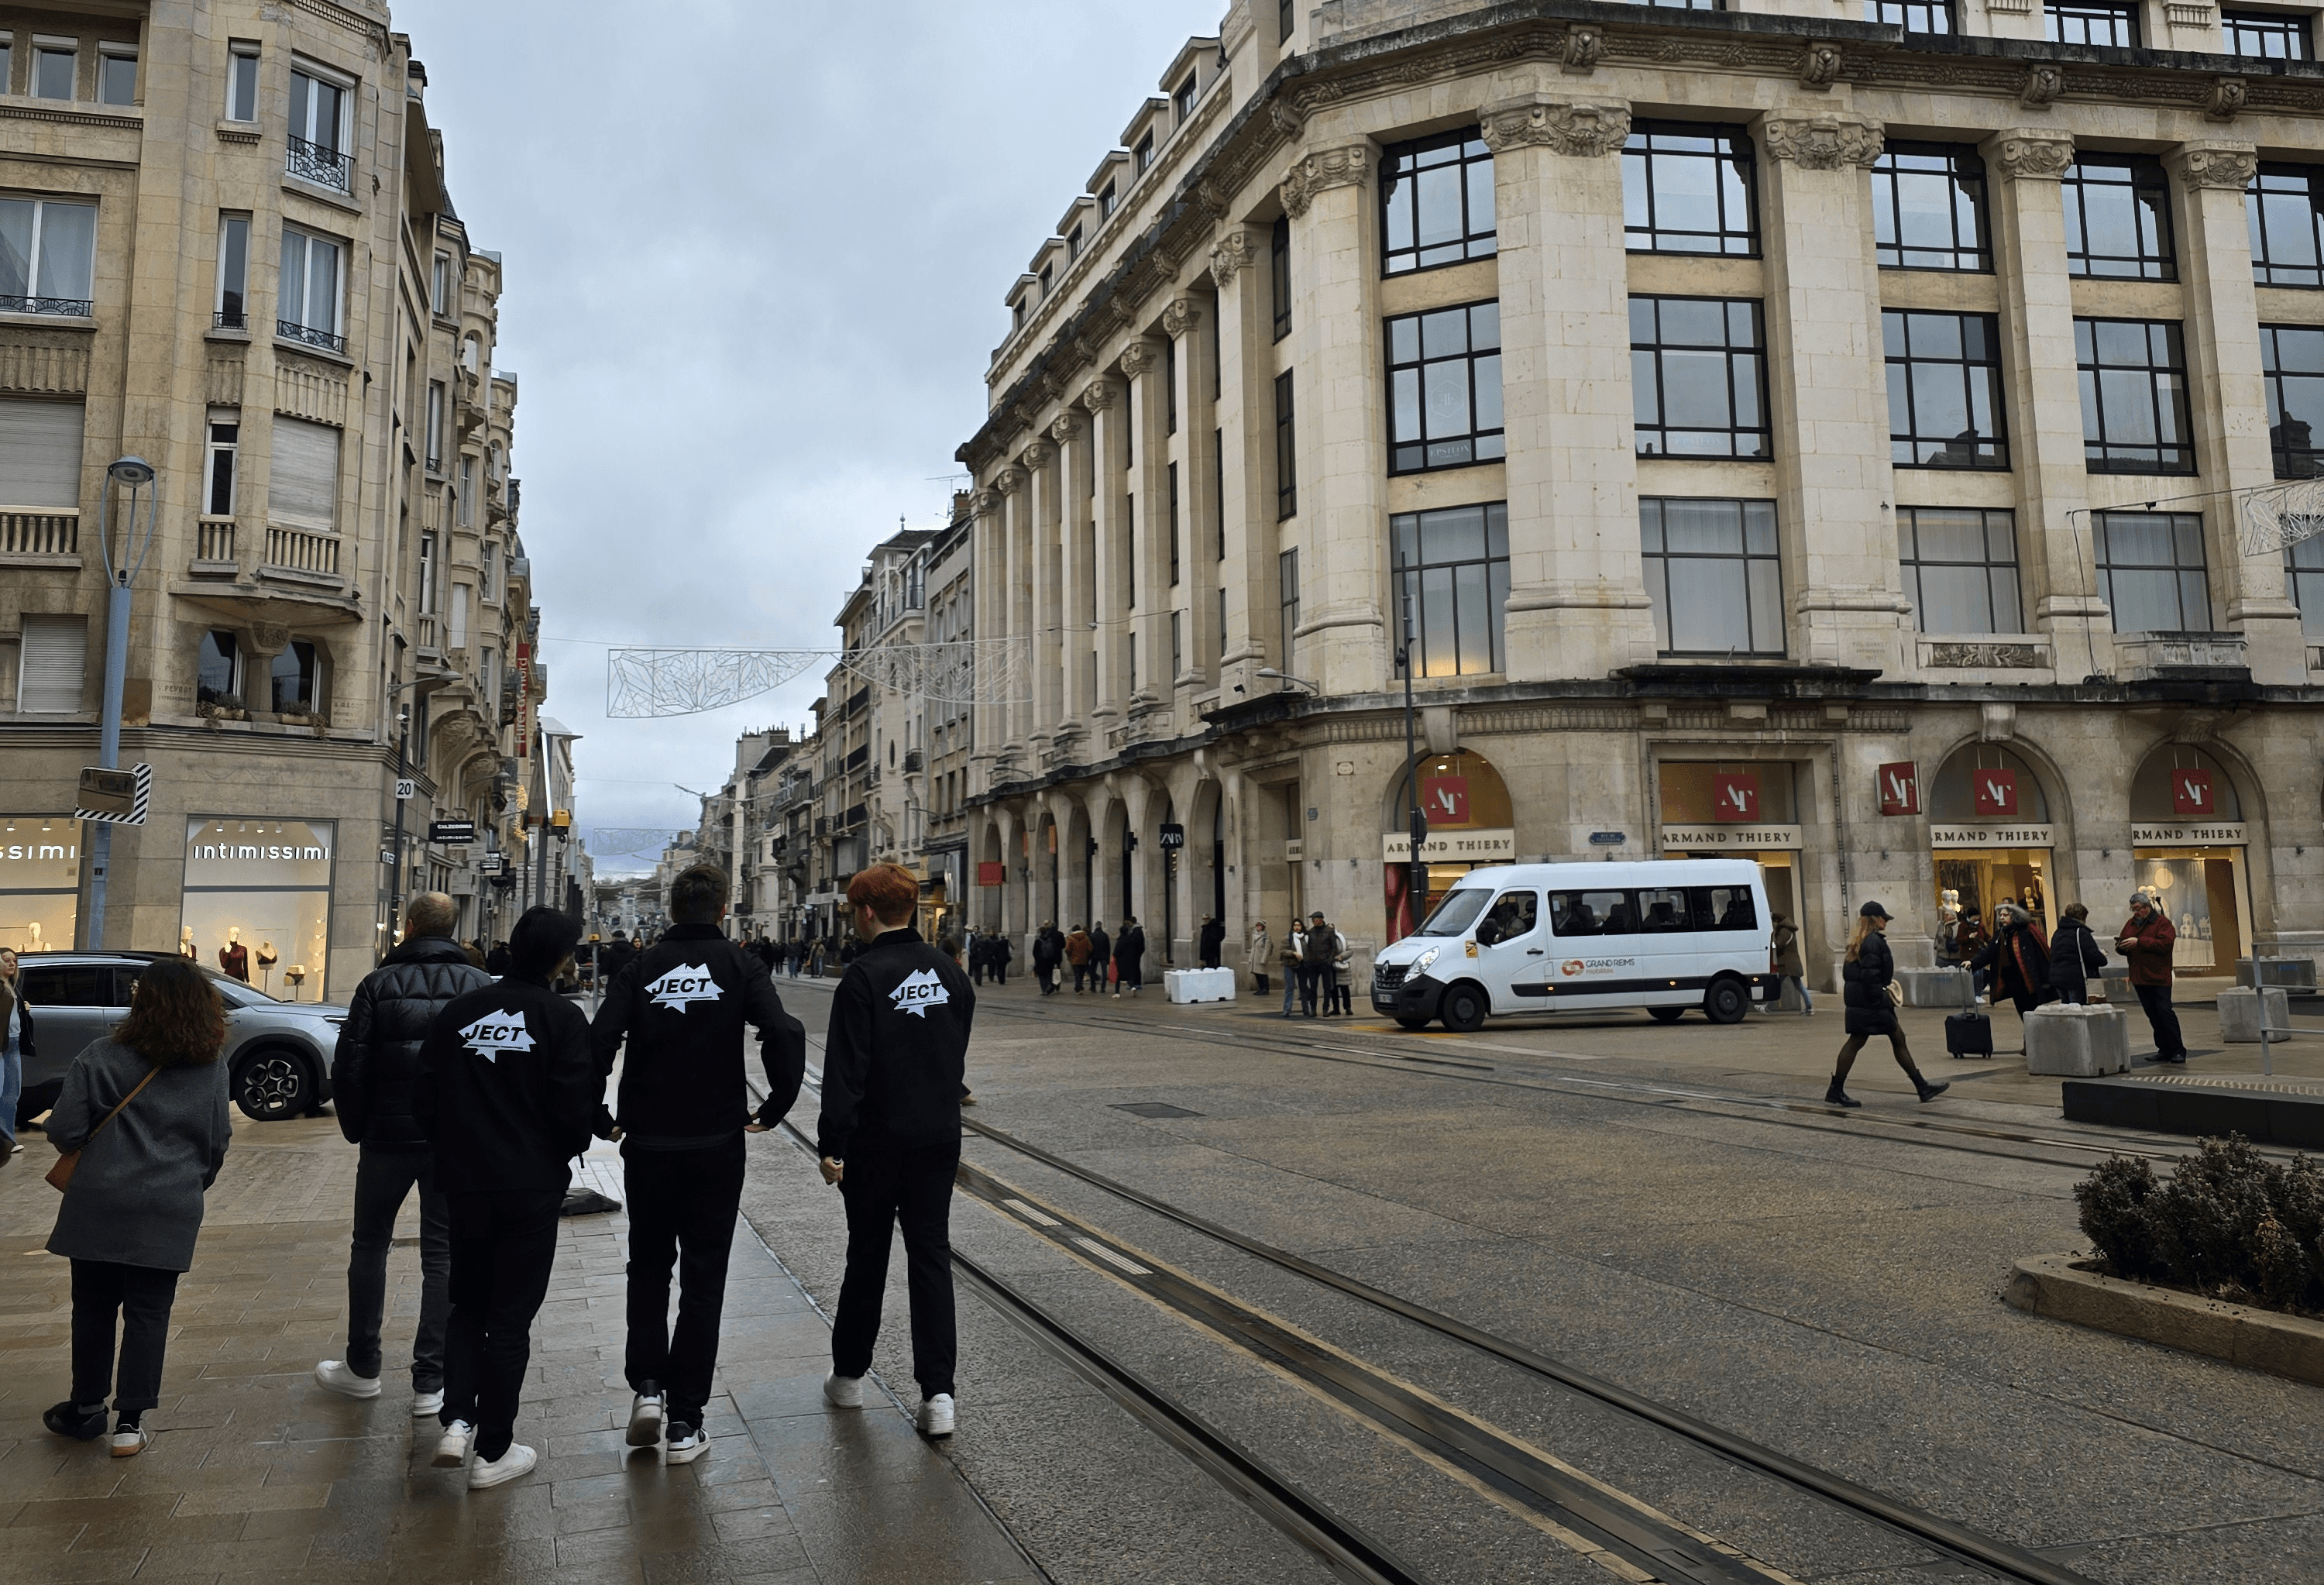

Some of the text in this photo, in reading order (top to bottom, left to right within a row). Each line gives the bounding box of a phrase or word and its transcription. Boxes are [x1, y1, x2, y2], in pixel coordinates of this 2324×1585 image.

[397, 782, 411, 795] 20
[1662, 832, 1791, 843] ARMAND THIERY
[1931, 831, 2048, 842] RMAND THIERY
[2192, 829, 2242, 839] THIERY
[1456, 839, 1511, 851] THIERY
[194, 842, 329, 861] intimissimi
[1586, 958, 1635, 968] GRAND REIMS
[652, 978, 711, 995] JECT
[895, 982, 941, 1001] JECT
[465, 1024, 525, 1042] JECT
